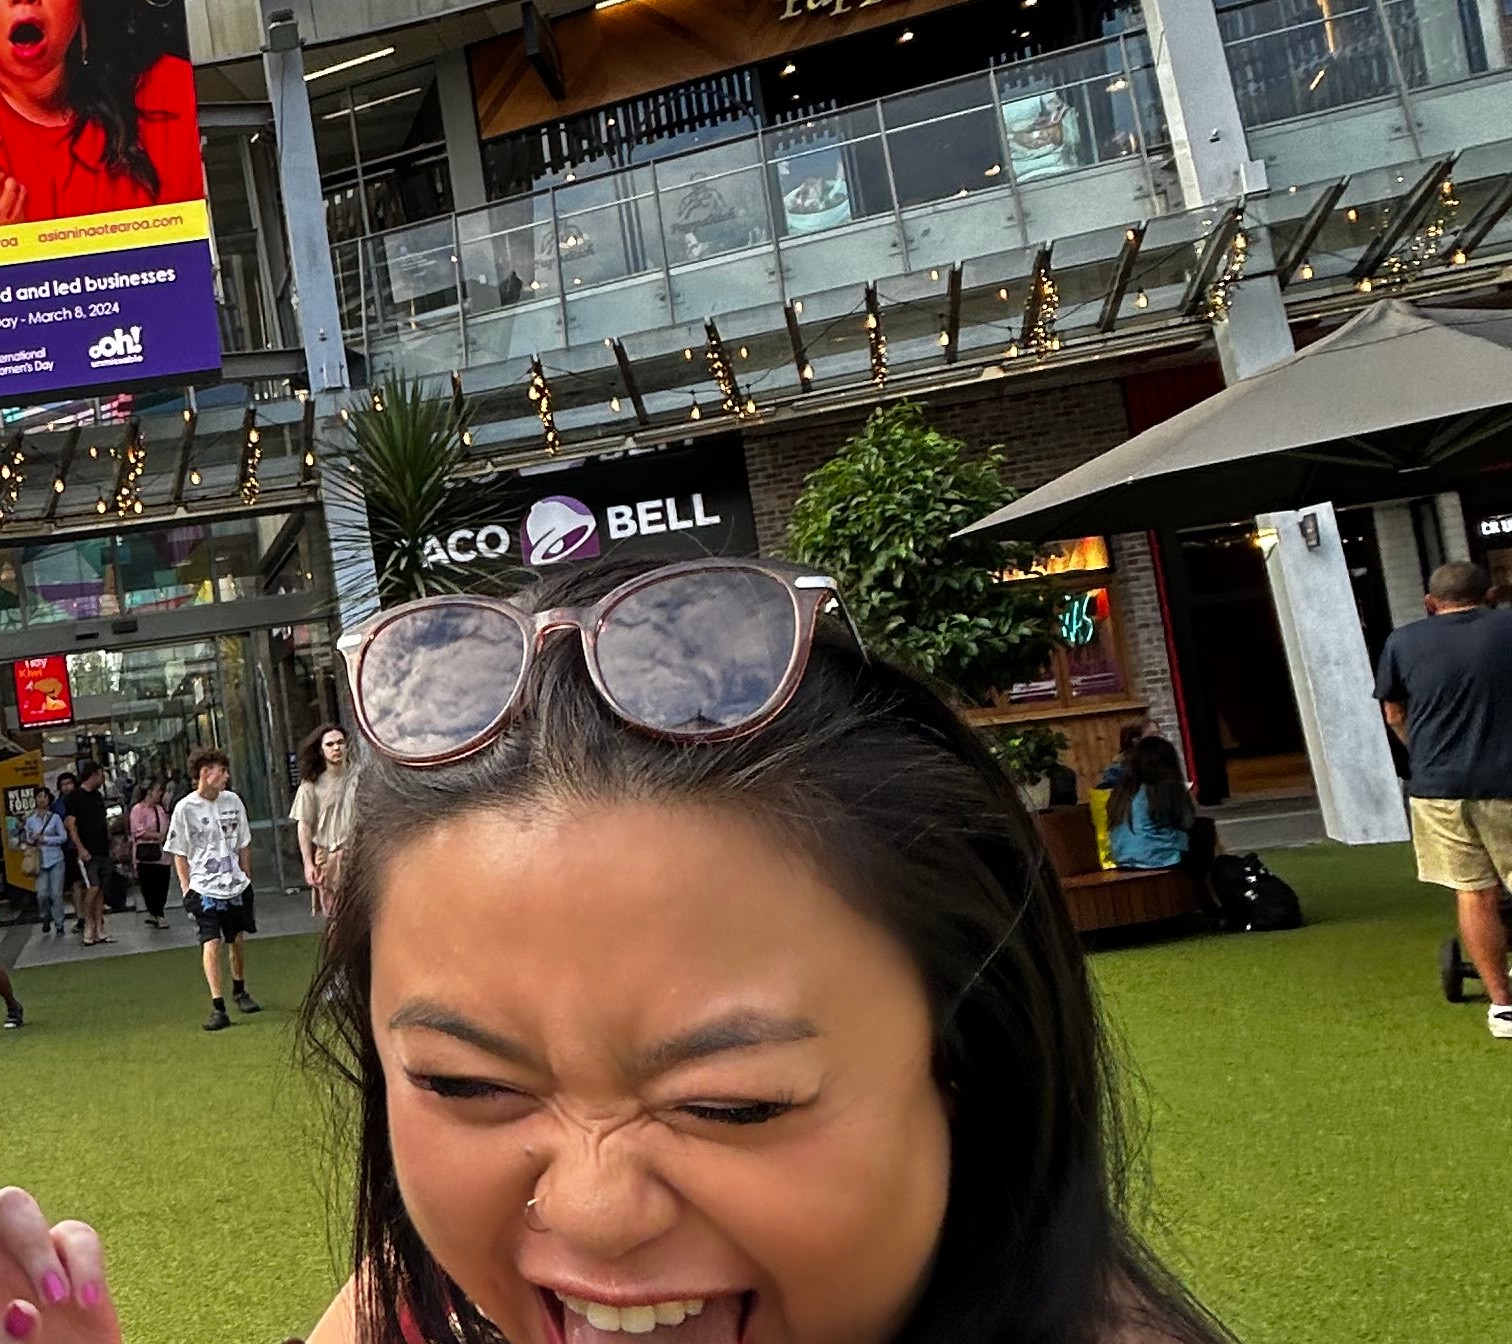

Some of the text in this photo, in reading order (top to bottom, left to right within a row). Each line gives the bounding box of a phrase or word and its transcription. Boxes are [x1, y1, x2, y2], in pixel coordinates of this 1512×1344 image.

[38, 214, 184, 243] asianinaotearoa.com
[15, 280, 51, 302] and
[52, 275, 82, 297] led
[84, 267, 177, 292] businesses
[28, 306, 73, 325] March
[74, 305, 87, 320] 8,
[88, 301, 121, 318] 2024
[34, 360, 54, 373] Day
[605, 492, 722, 540] BELL
